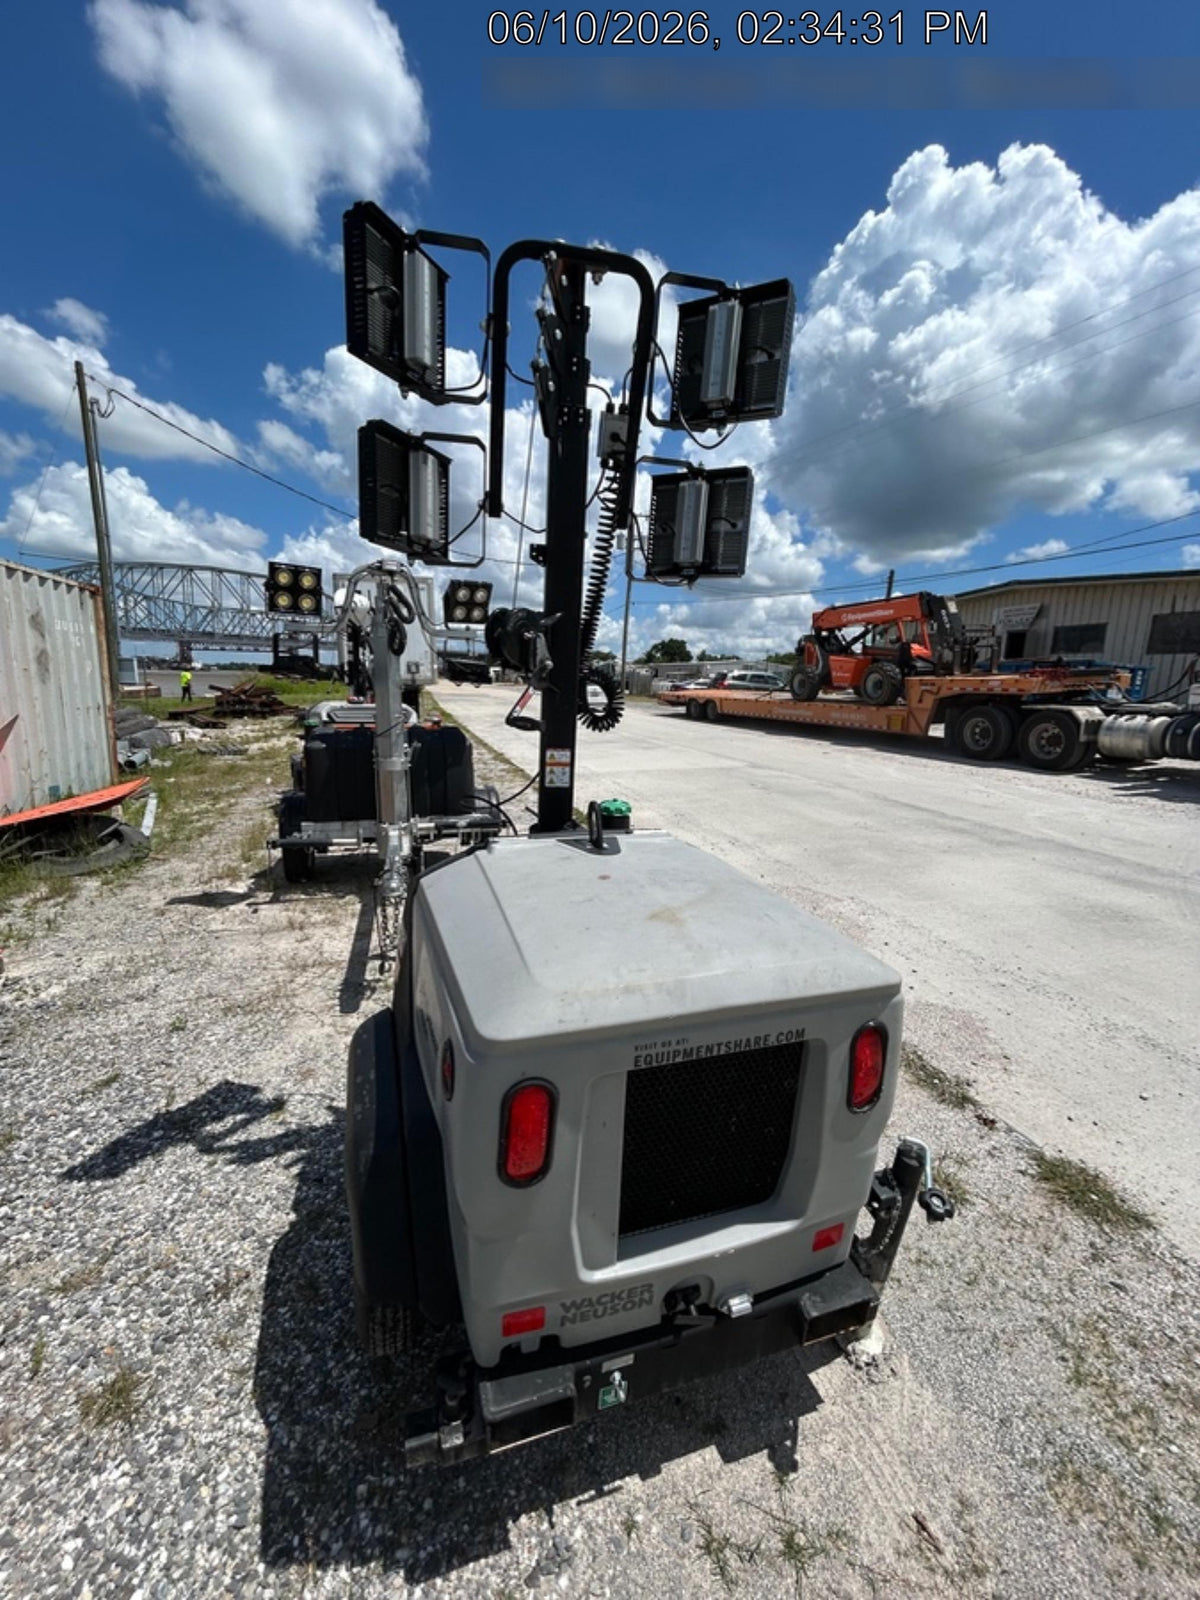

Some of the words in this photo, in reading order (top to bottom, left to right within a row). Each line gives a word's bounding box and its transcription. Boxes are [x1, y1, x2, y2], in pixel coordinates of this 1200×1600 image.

[634, 1028, 806, 1068] EQUIPMENTSHARE.COM
[560, 1283, 654, 1313] WACKER
[560, 1294, 655, 1327] NEUSON
